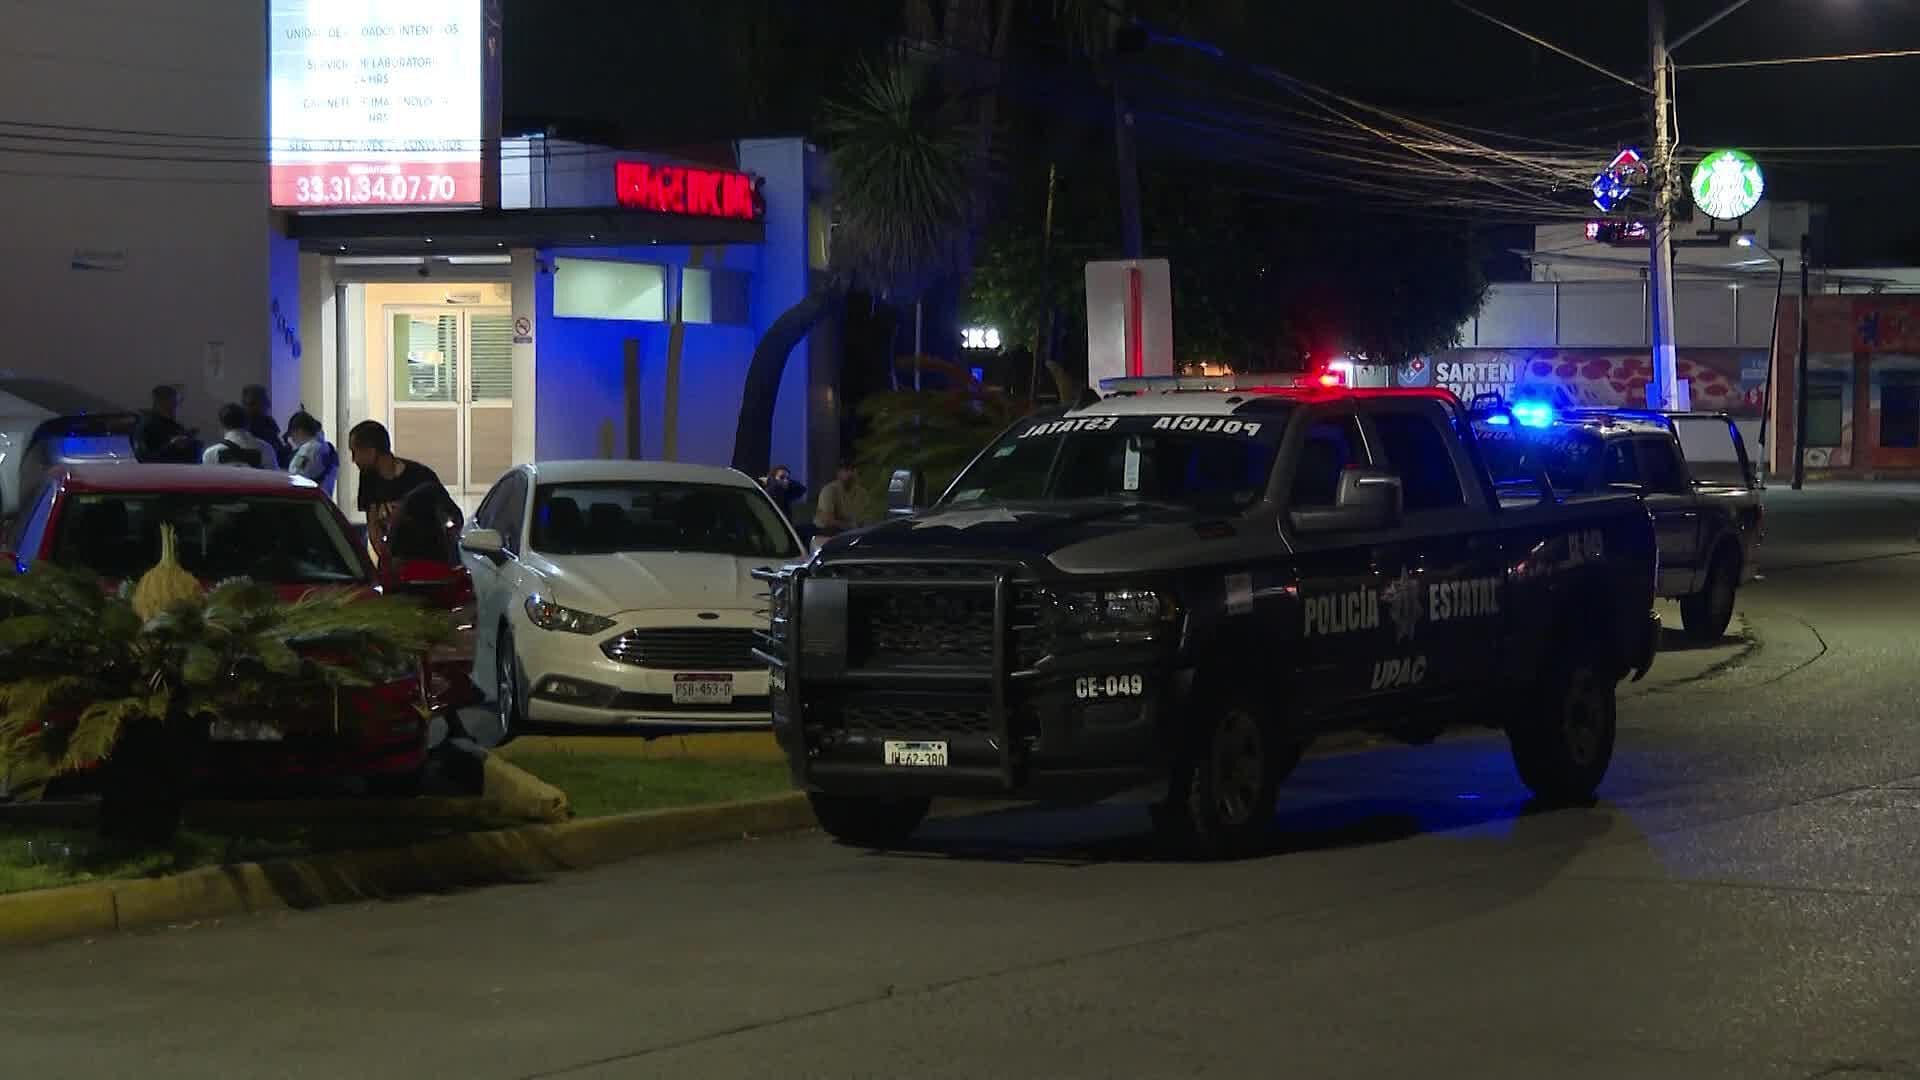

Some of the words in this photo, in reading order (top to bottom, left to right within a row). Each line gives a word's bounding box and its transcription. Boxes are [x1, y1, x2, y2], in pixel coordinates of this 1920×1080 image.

[296, 175, 456, 203] 33.31.34.07.70
[1436, 357, 1514, 382] SARTÉN
[1435, 383, 1516, 406] RANDE
[1304, 584, 1380, 636] POLICÍA
[1429, 579, 1500, 621] ESTATAL
[1075, 674, 1143, 698] CE-049
